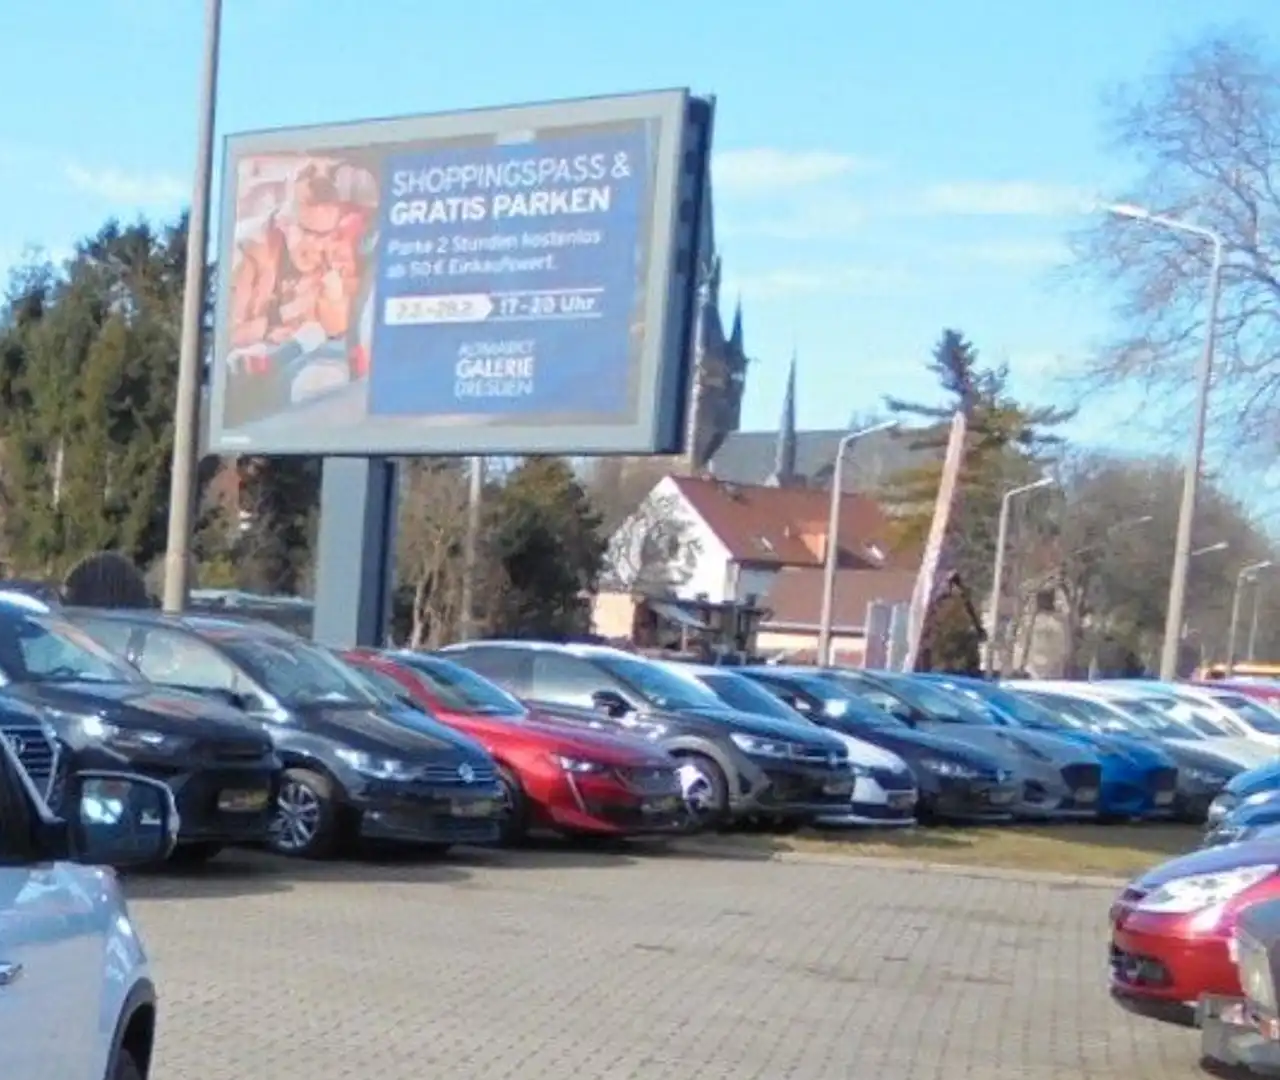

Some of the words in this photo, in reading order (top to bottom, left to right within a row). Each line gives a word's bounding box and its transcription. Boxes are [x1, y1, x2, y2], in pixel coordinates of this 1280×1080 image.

[391, 153, 605, 197] SHOPPINGSPASS
[610, 151, 631, 179] &
[390, 196, 486, 226] GRATIS
[493, 186, 611, 220] PARKEN
[436, 236, 450, 254] 2
[452, 233, 517, 252] Stunden
[560, 294, 596, 312] Uhr
[456, 357, 534, 379] GALERIE
